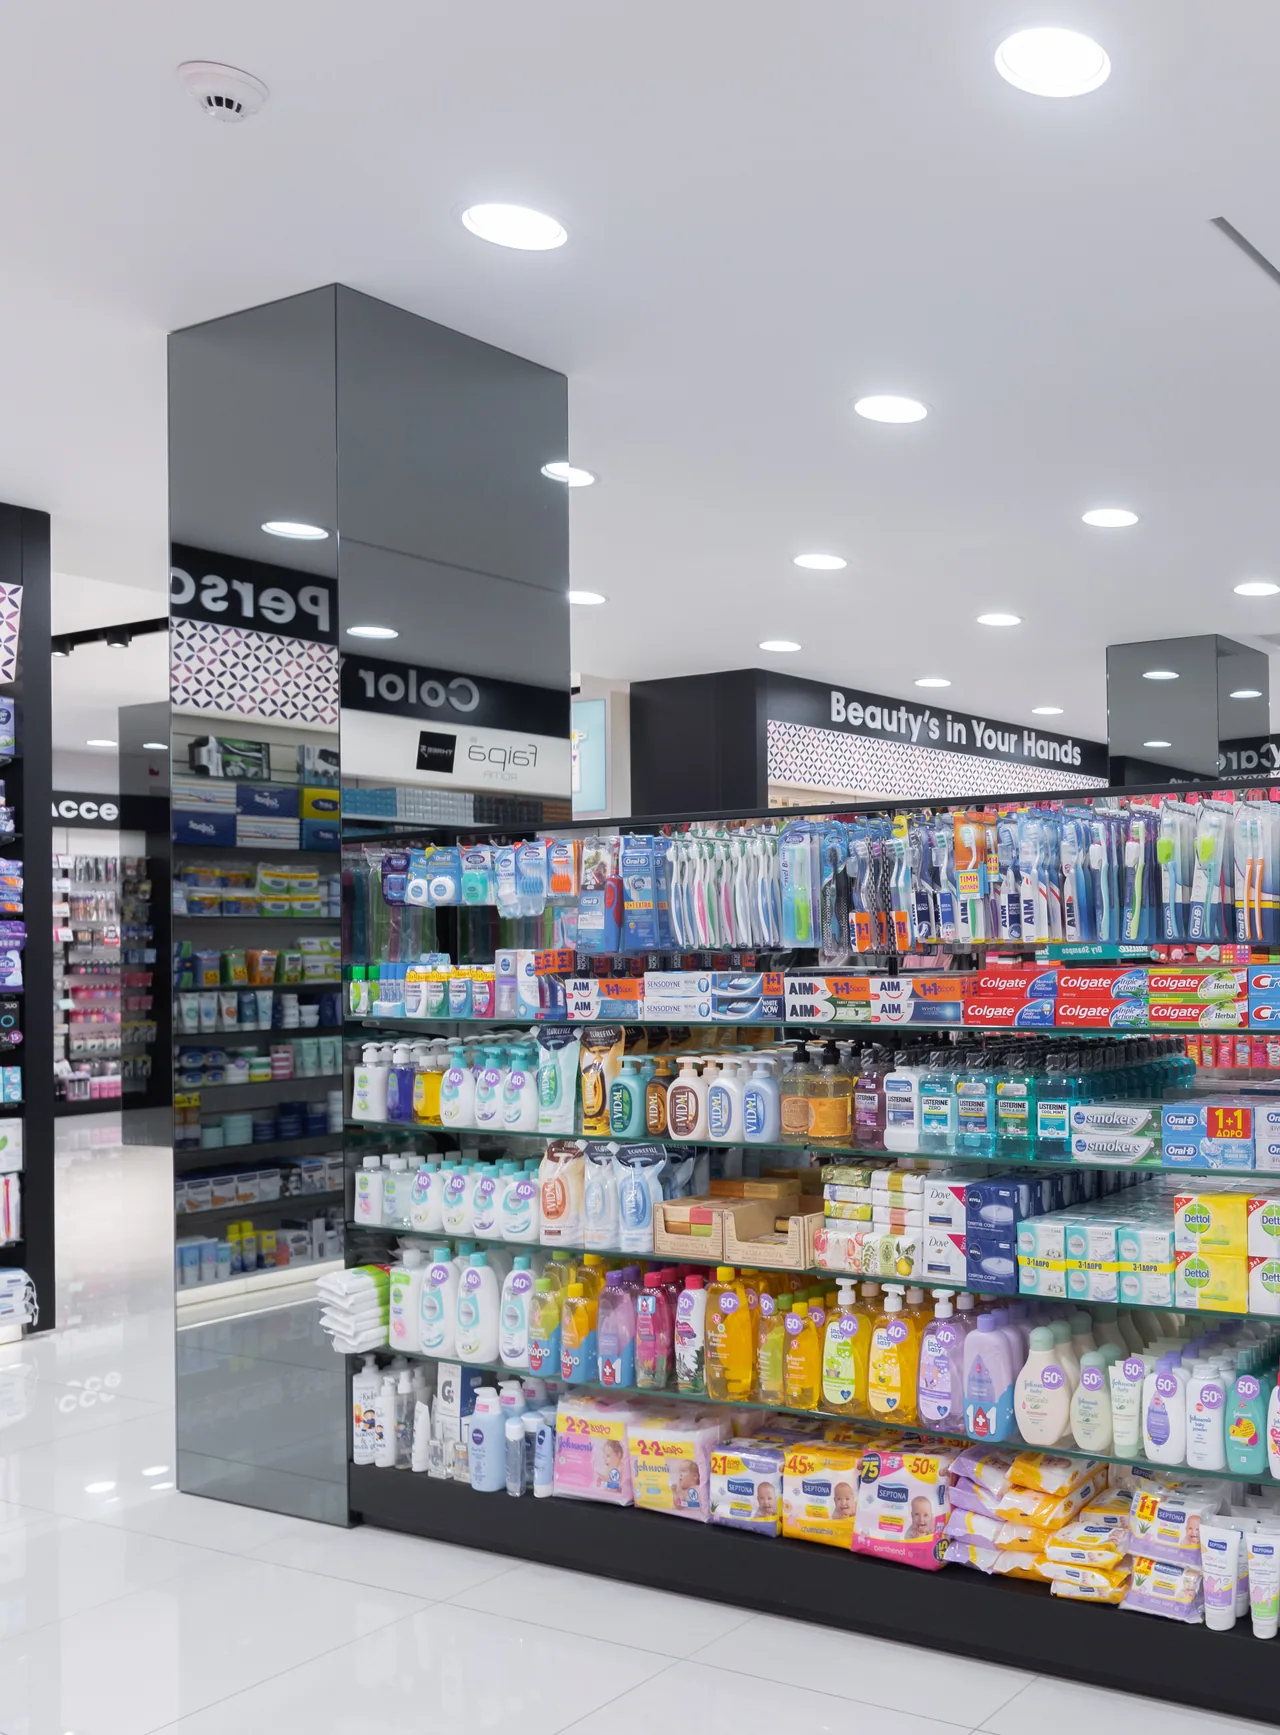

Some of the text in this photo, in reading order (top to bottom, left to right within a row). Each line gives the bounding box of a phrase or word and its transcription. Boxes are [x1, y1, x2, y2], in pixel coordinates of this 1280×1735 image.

[830, 691, 1082, 766] Beauty's in Your Hands
[959, 874, 978, 883] ΤΙΜΗ
[961, 902, 969, 925] AIM
[647, 980, 681, 989] SENSODYNE
[765, 973, 781, 985] 1+1
[980, 977, 1028, 990] Colgate
[1060, 975, 1112, 991] Colgate
[1120, 977, 1138, 986] Triple
[1150, 974, 1199, 992] Colgate
[573, 982, 591, 992] AIM
[789, 982, 814, 995] AIM
[833, 982, 849, 994] 1+1
[879, 981, 900, 991] AIM
[920, 983, 937, 994] 1+1
[1114, 984, 1136, 992] Action
[1213, 982, 1236, 991] Herbal
[574, 1001, 592, 1011] AIM
[647, 1004, 681, 1013] SENSODYNE
[762, 1006, 778, 1014] NOW
[790, 1005, 815, 1018] AIM
[880, 1003, 900, 1014] AIM
[967, 1004, 1015, 1017] Colgate
[1059, 1003, 1111, 1019] Colgate
[1118, 1007, 1136, 1015] Triple
[1113, 1013, 1135, 1021] Action
[1150, 1004, 1200, 1021] Colgate
[1214, 1012, 1238, 1020] Herbal
[613, 1083, 625, 1120] VIDAL
[959, 1100, 985, 1108] LISTERINE
[1039, 1103, 1067, 1111] LISTERINE
[647, 1091, 659, 1127] VIDAL
[675, 1091, 688, 1127] VIDAL
[711, 1092, 723, 1129] VIDAL
[745, 1091, 757, 1133] VIDAL
[1086, 1112, 1139, 1125] smokers
[1168, 1115, 1197, 1125] Oral-B
[1214, 1108, 1244, 1130] 1+1
[1216, 1129, 1244, 1139] ΔΩΡΟ
[1088, 1139, 1141, 1152] smokers
[1168, 1145, 1197, 1155] Oral-B
[930, 1190, 950, 1200] Dove
[1175, 1198, 1188, 1209] 3+1
[1248, 1200, 1260, 1212] 3+1
[1184, 1213, 1211, 1225] Dettol
[927, 1238, 949, 1248] Dove
[1175, 1252, 1188, 1263] 3+1
[1249, 1257, 1261, 1269] 3+1
[1184, 1267, 1210, 1280] Dettol
[634, 1459, 670, 1475] Johnson's
[710, 1455, 728, 1475] 2+1
[785, 1453, 815, 1473] -45%
[861, 1459, 880, 1476] 75
[906, 1457, 936, 1474] -50%
[728, 1483, 753, 1494] SEPTONA
[804, 1484, 831, 1495] SEPTONA
[879, 1488, 907, 1500] SEPTONA
[1139, 1496, 1159, 1516] 1+1
[1158, 1510, 1185, 1522] SEPTONA
[1209, 1541, 1227, 1550] SEPTONA
[1252, 1546, 1273, 1554] SEPTONA
